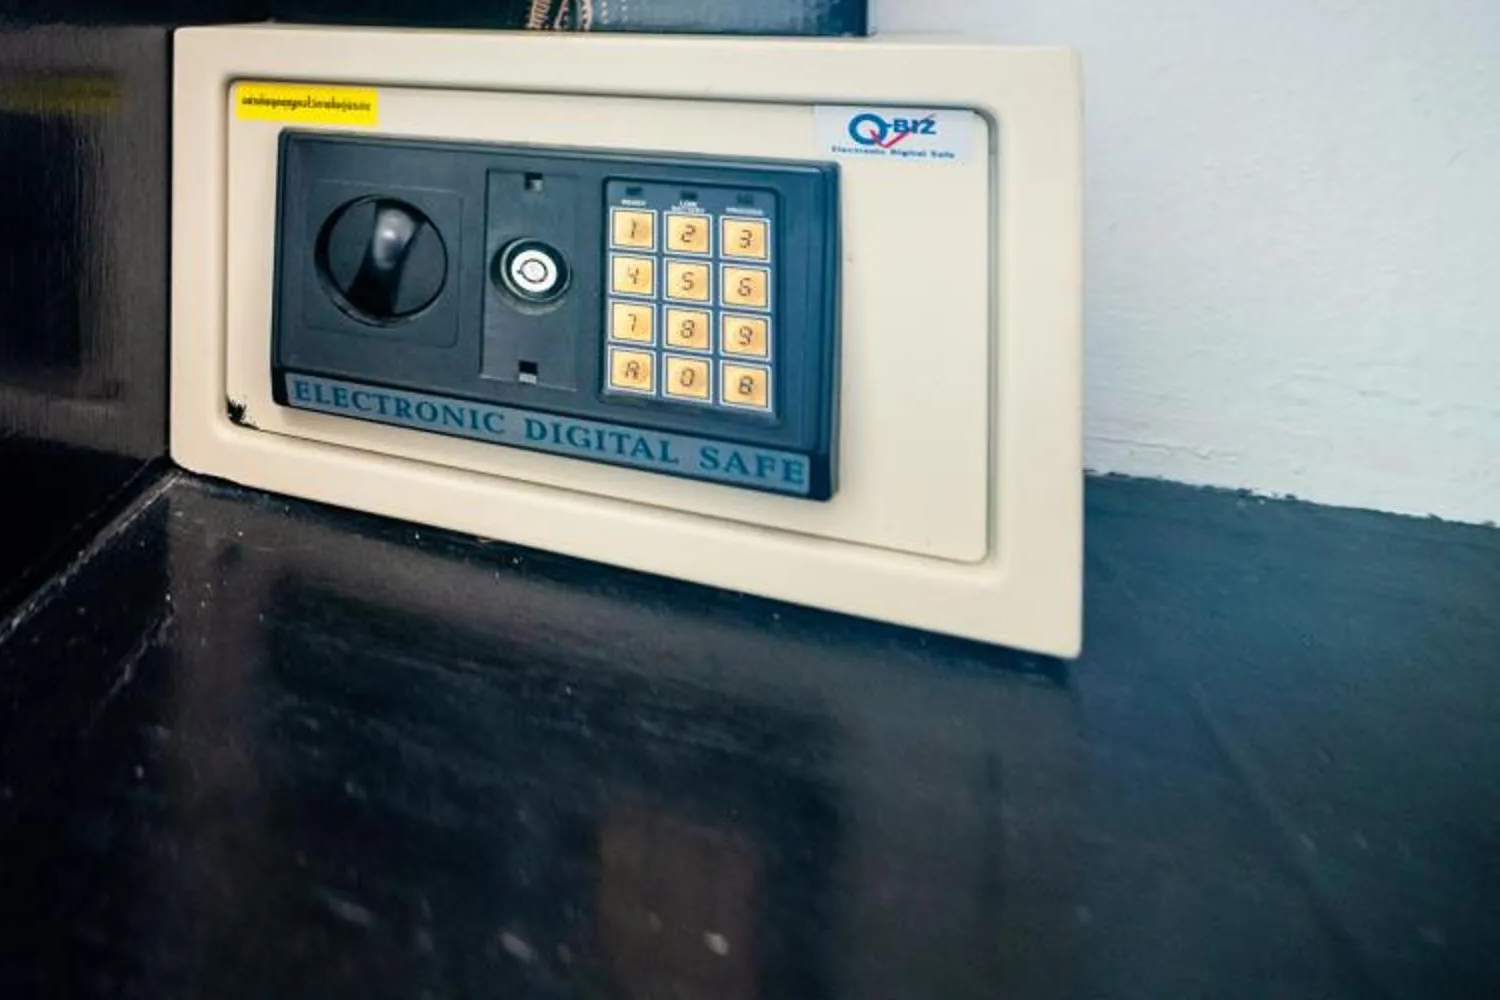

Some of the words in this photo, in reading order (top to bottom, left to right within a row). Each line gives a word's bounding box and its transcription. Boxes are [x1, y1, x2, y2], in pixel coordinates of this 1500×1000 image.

[831, 145, 886, 156] Electronic
[890, 148, 927, 158] Digital
[628, 219, 637, 239] 1
[680, 224, 696, 243] 2
[739, 229, 753, 249] 3
[627, 266, 639, 285] 4
[681, 271, 694, 292] 5
[738, 277, 751, 297] 6
[627, 313, 638, 332] 7
[680, 319, 695, 339] 8
[739, 326, 753, 346] 9
[624, 360, 641, 380] A
[680, 367, 695, 388] 0
[292, 379, 506, 435] ELECTRONIC
[524, 421, 679, 464] DIGITAL
[699, 445, 804, 485] SAFE
